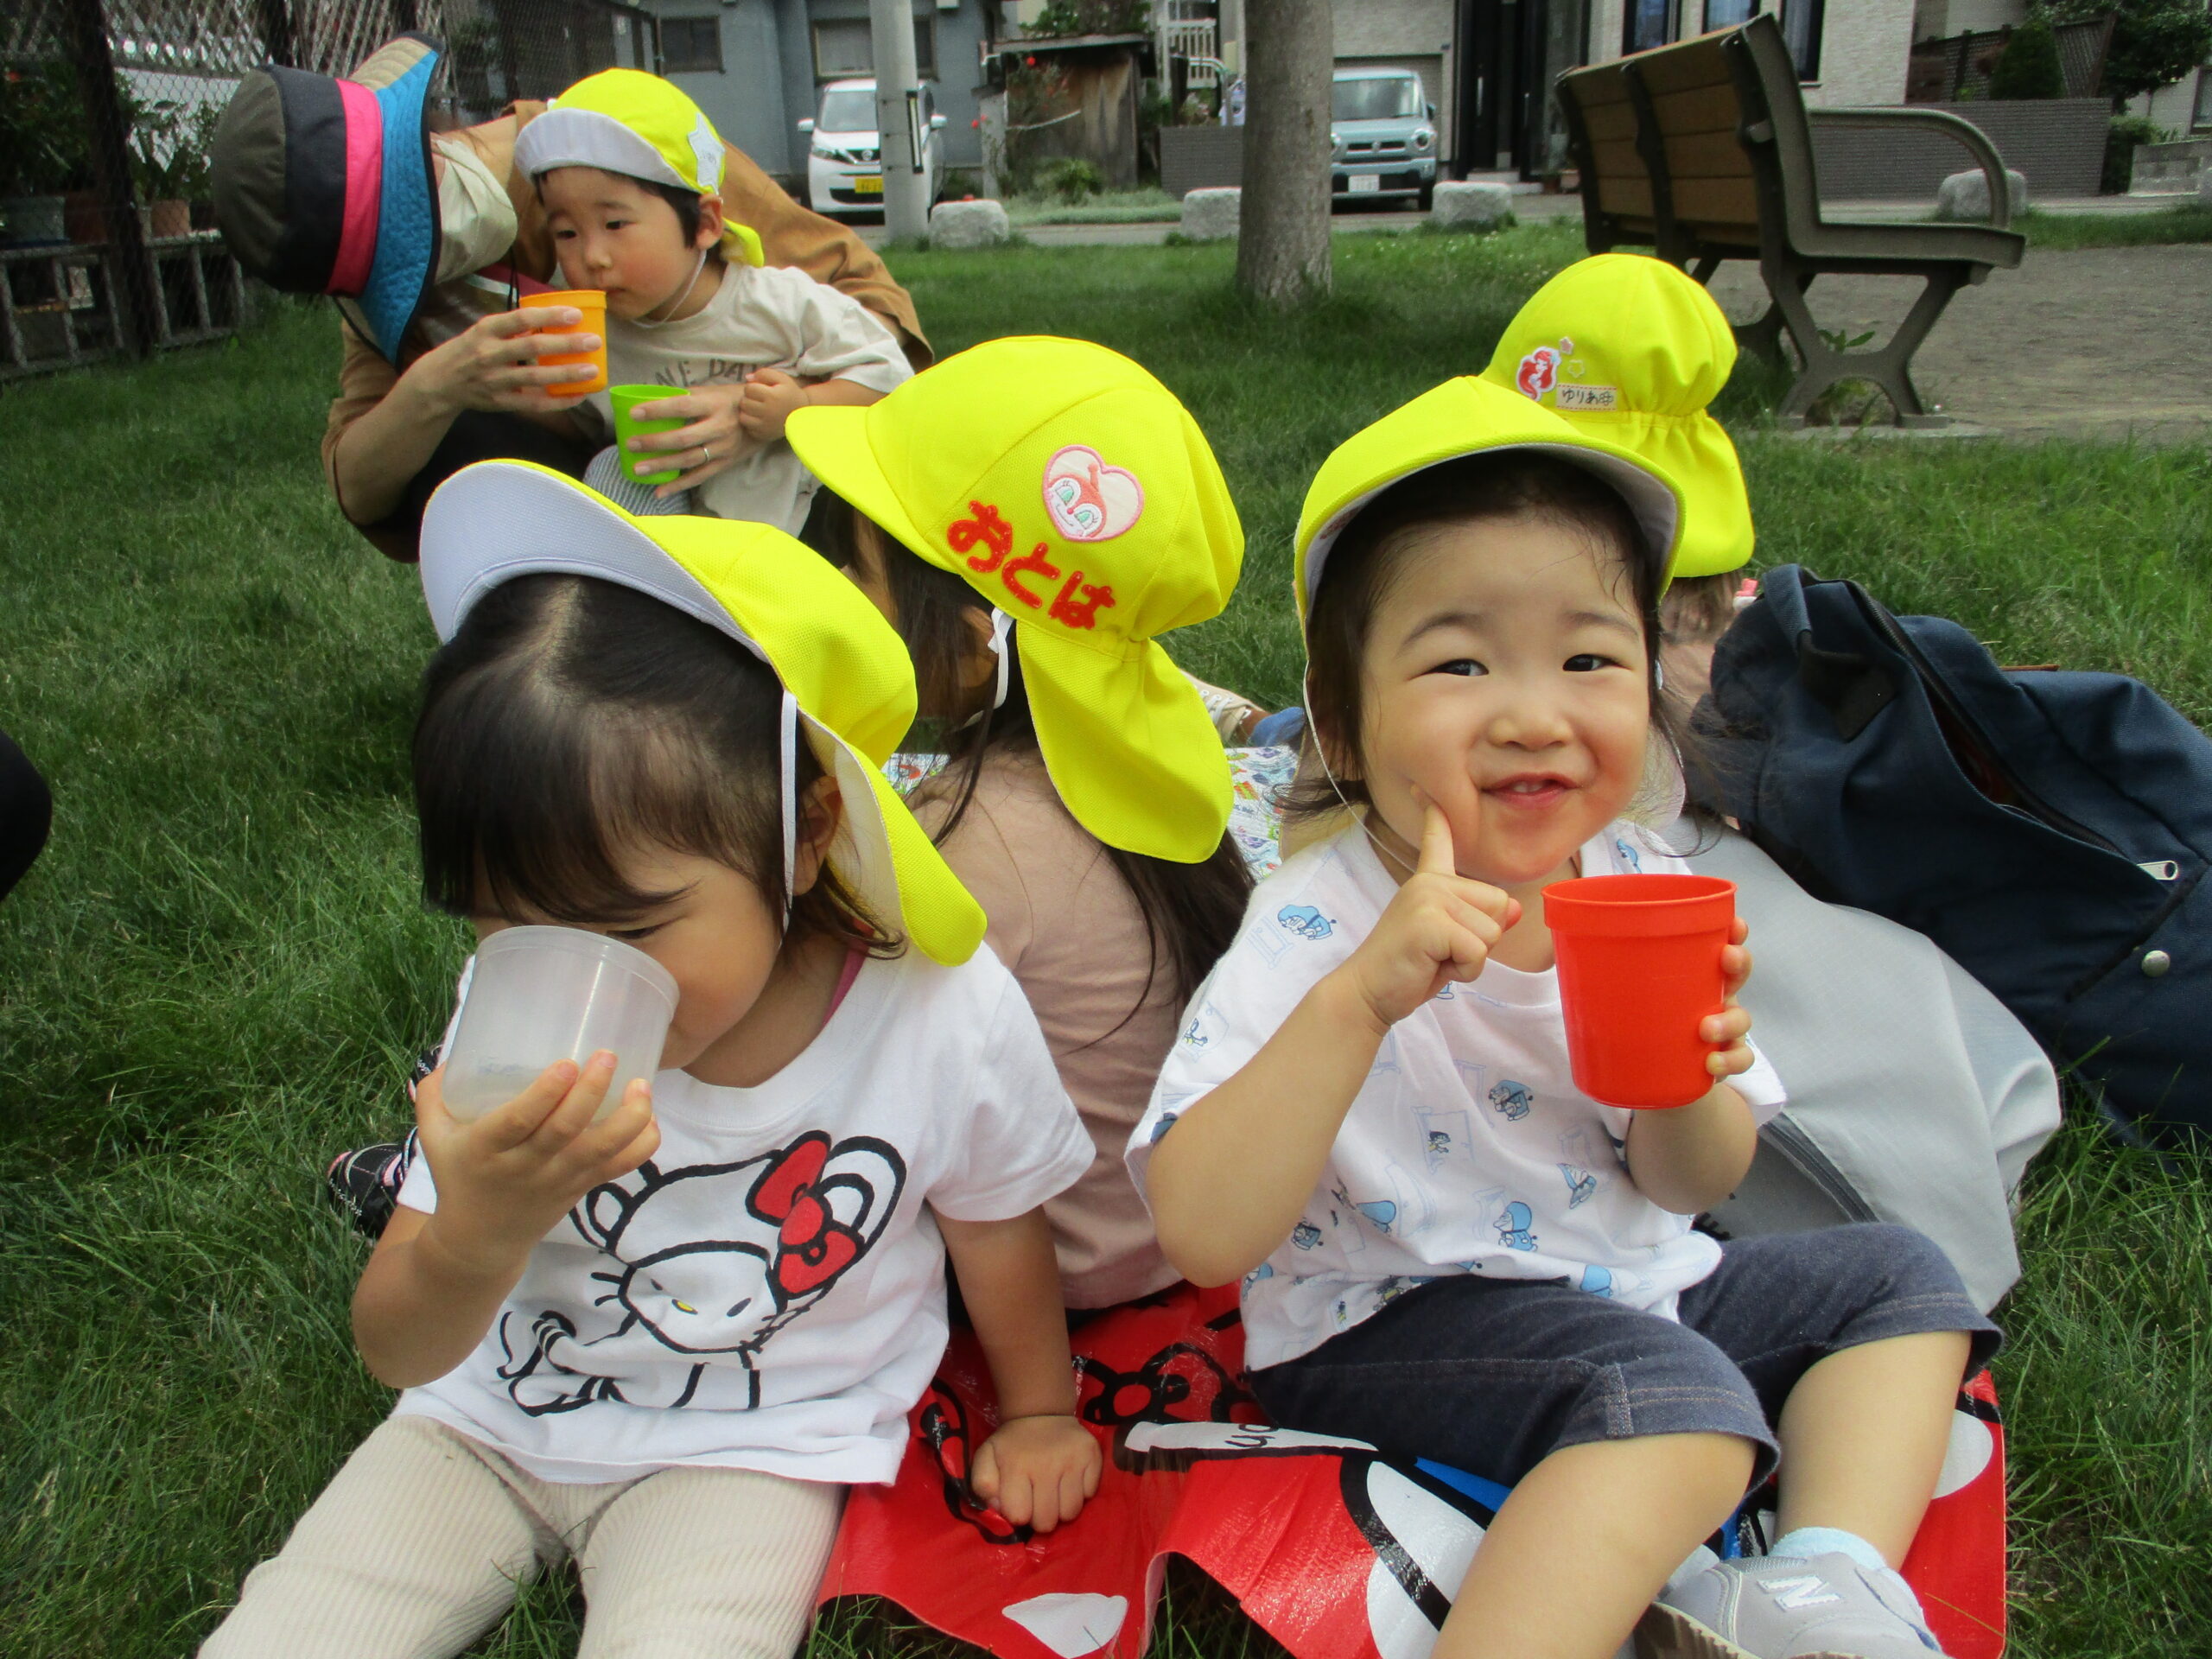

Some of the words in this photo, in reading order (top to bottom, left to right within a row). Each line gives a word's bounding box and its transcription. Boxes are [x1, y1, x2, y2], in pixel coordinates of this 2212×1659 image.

[1561, 388, 1599, 404] ゆりあ
[947, 499, 1116, 630] おとは
